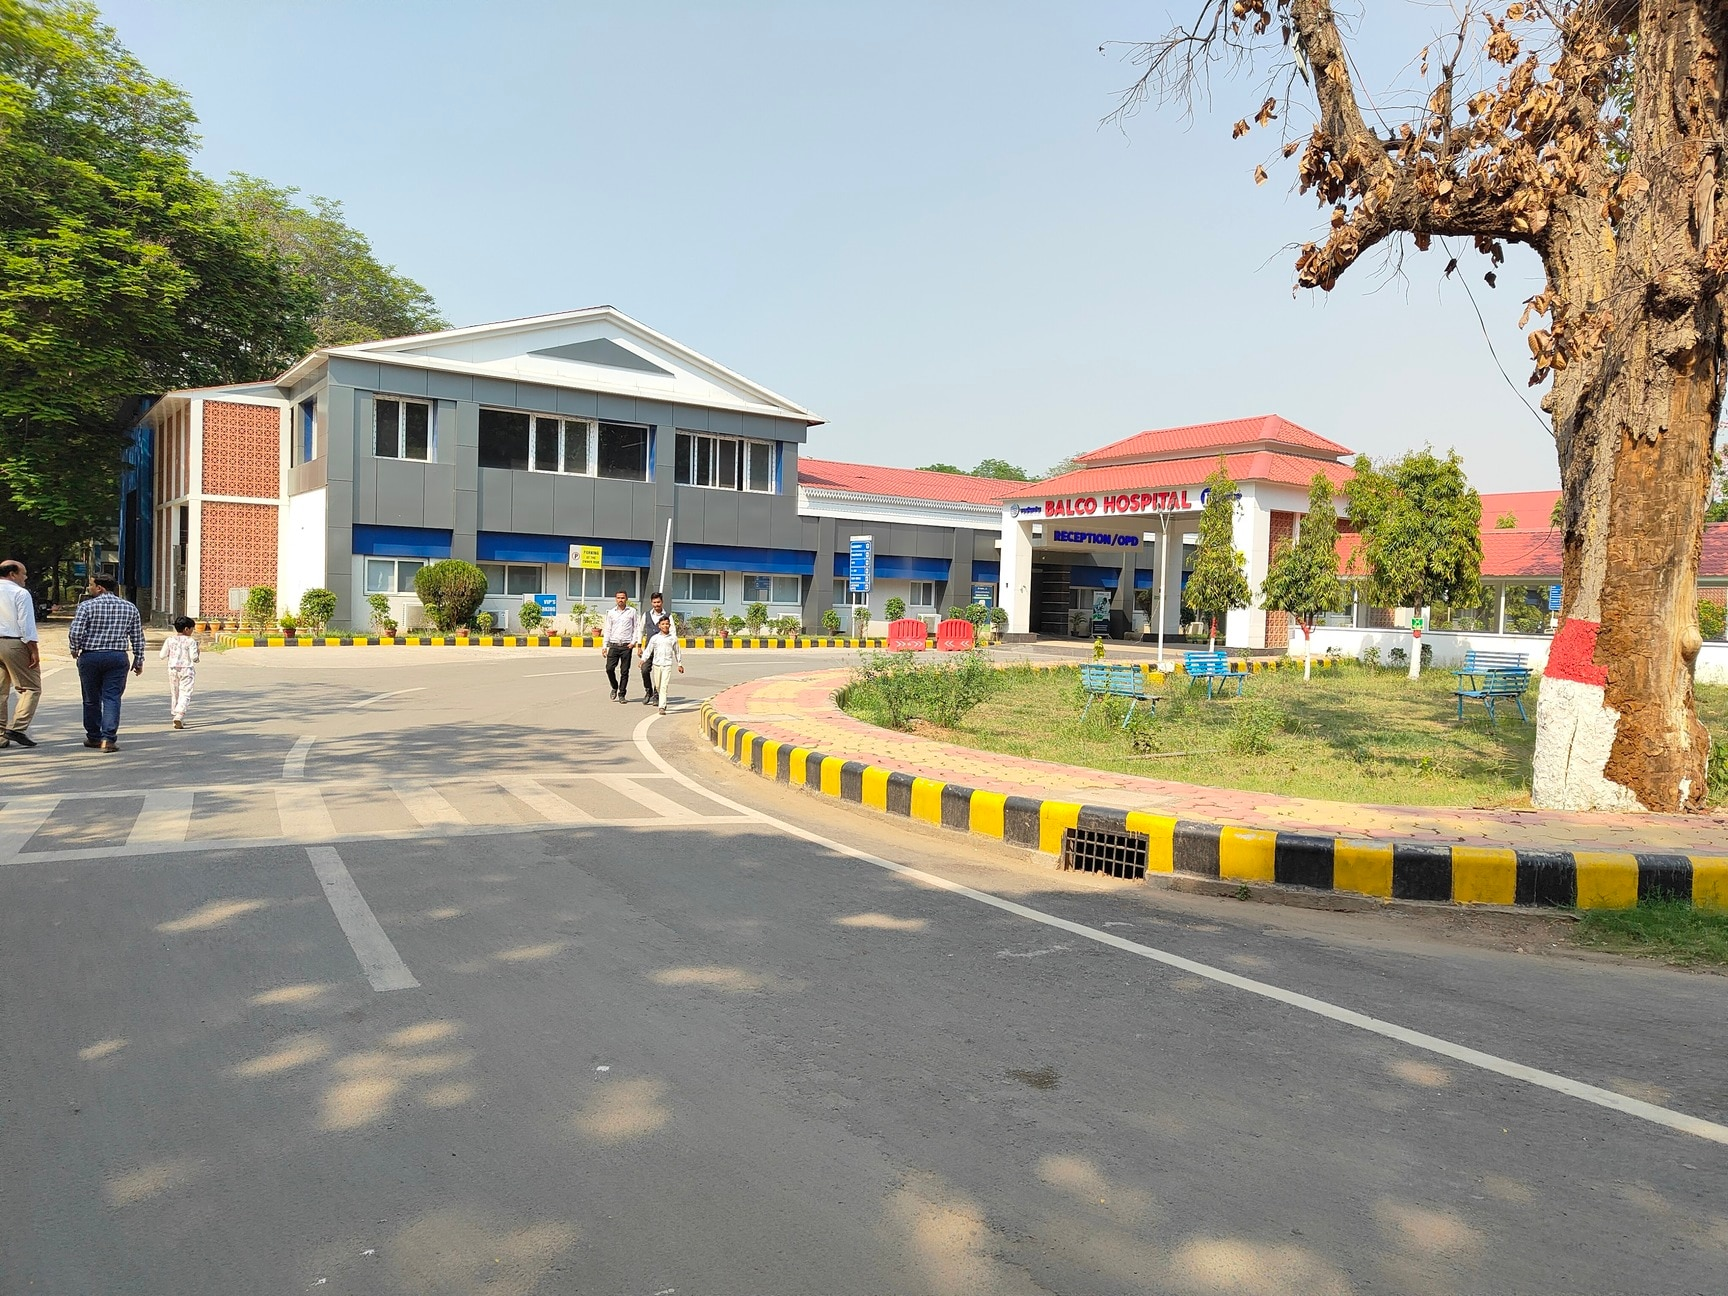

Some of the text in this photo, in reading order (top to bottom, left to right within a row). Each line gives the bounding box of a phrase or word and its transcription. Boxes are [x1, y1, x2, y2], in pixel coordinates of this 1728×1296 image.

[1044, 490, 1191, 517] BALCO HOSPITAL
[1054, 530, 1139, 547] RECEPTION/OPD
